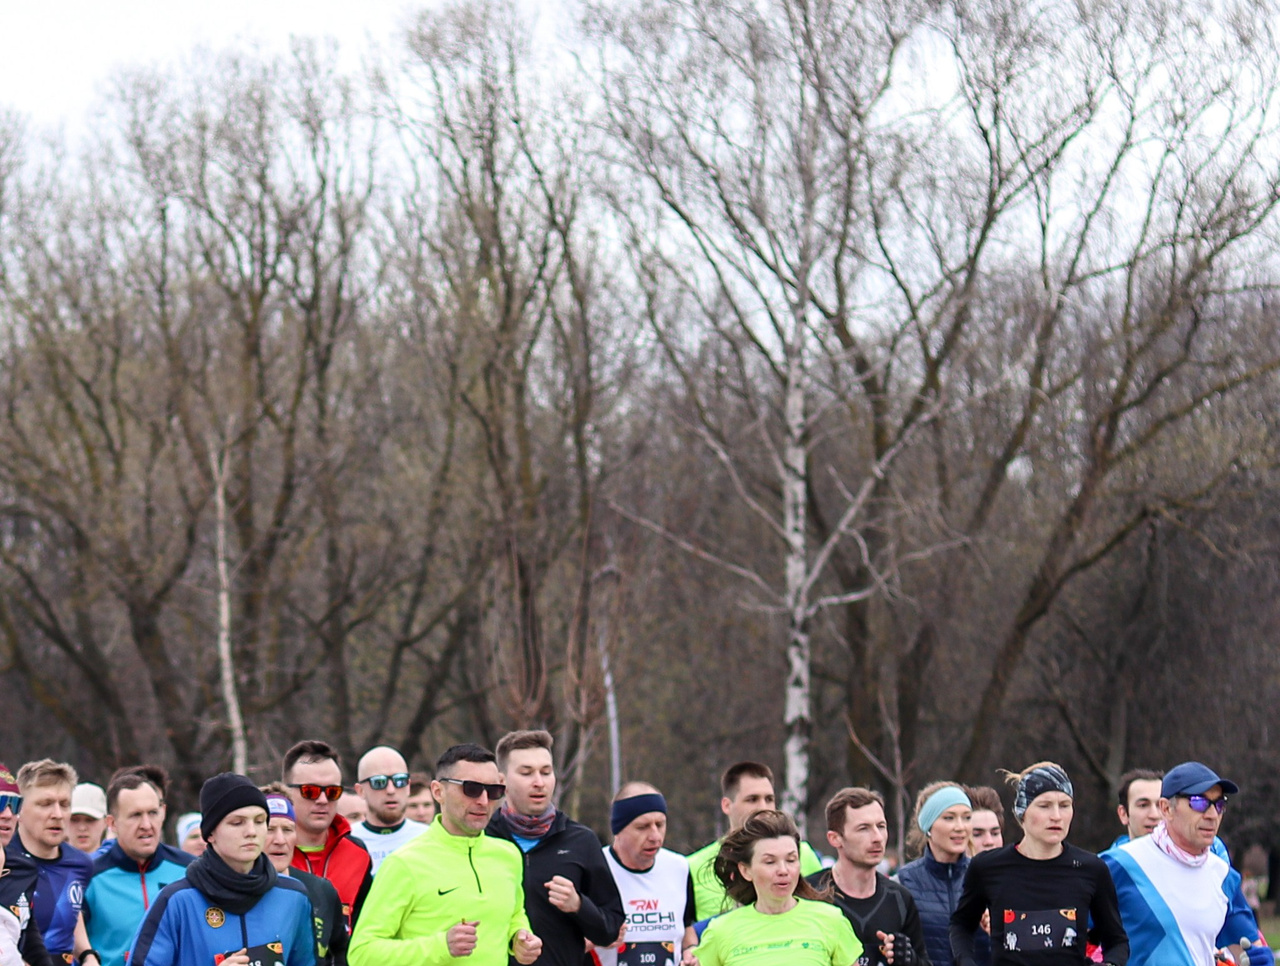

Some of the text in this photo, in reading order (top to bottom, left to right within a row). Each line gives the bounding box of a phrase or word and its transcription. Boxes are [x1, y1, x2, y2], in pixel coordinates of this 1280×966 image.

[629, 899, 659, 911] RAY
[624, 924, 676, 933] UTODROM
[1031, 924, 1051, 935] 146
[640, 953, 656, 963] 100
